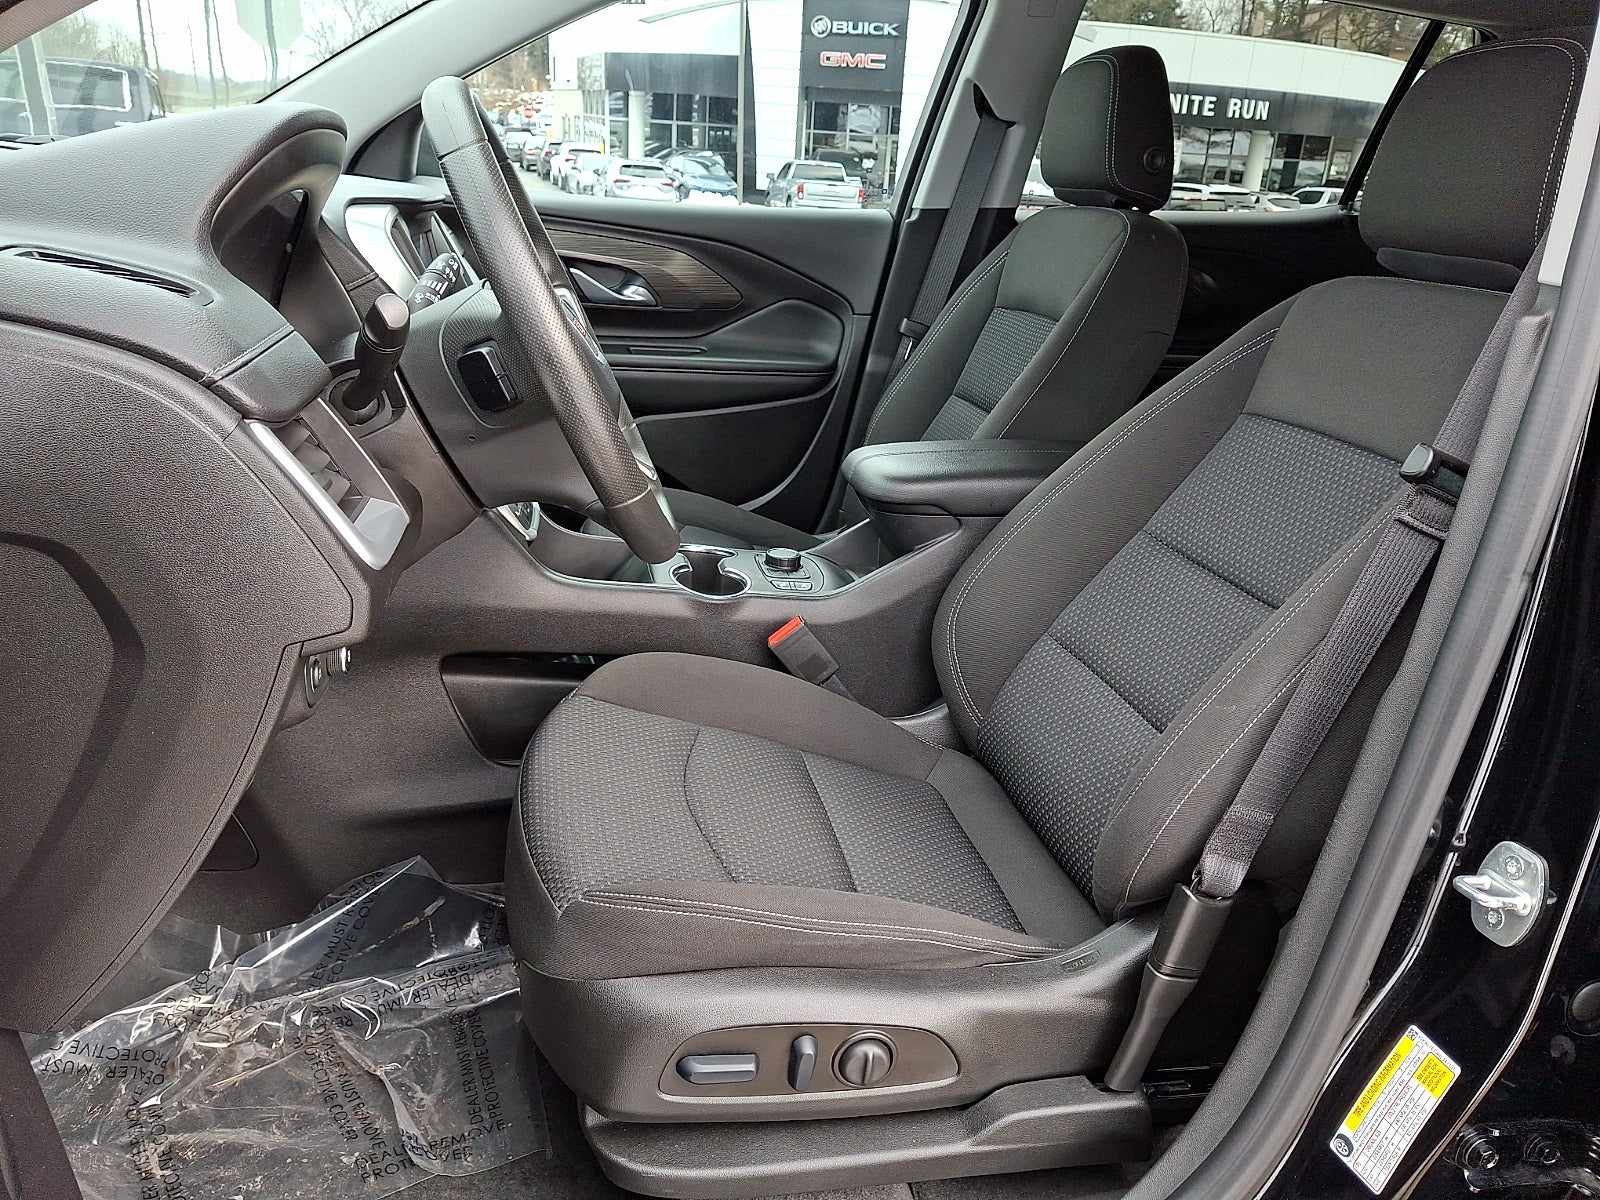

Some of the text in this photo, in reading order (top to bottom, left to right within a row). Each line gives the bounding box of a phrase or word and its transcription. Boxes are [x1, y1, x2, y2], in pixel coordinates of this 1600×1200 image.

[832, 20, 900, 36] BUICK
[820, 51, 886, 69] GMC
[1227, 98, 1270, 121] RUN
[324, 921, 348, 959] MUST
[328, 934, 358, 984] ECTIVE
[69, 1039, 170, 1070] PROTECTIVE
[457, 1051, 474, 1077] MUST
[467, 1008, 502, 1119] PROTECTIVE COVER
[1376, 1050, 1402, 1082] INFORMATION
[106, 1065, 165, 1086] DEALER
[1363, 1077, 1383, 1100] LOADING
[305, 1047, 358, 1141] OTECTIVE COVER
[463, 1079, 484, 1125] DEALER
[1357, 1095, 1370, 1109] AND
[337, 1073, 361, 1103] MUST
[352, 1102, 387, 1150] REMOVE
[1352, 1104, 1364, 1118] TIRE
